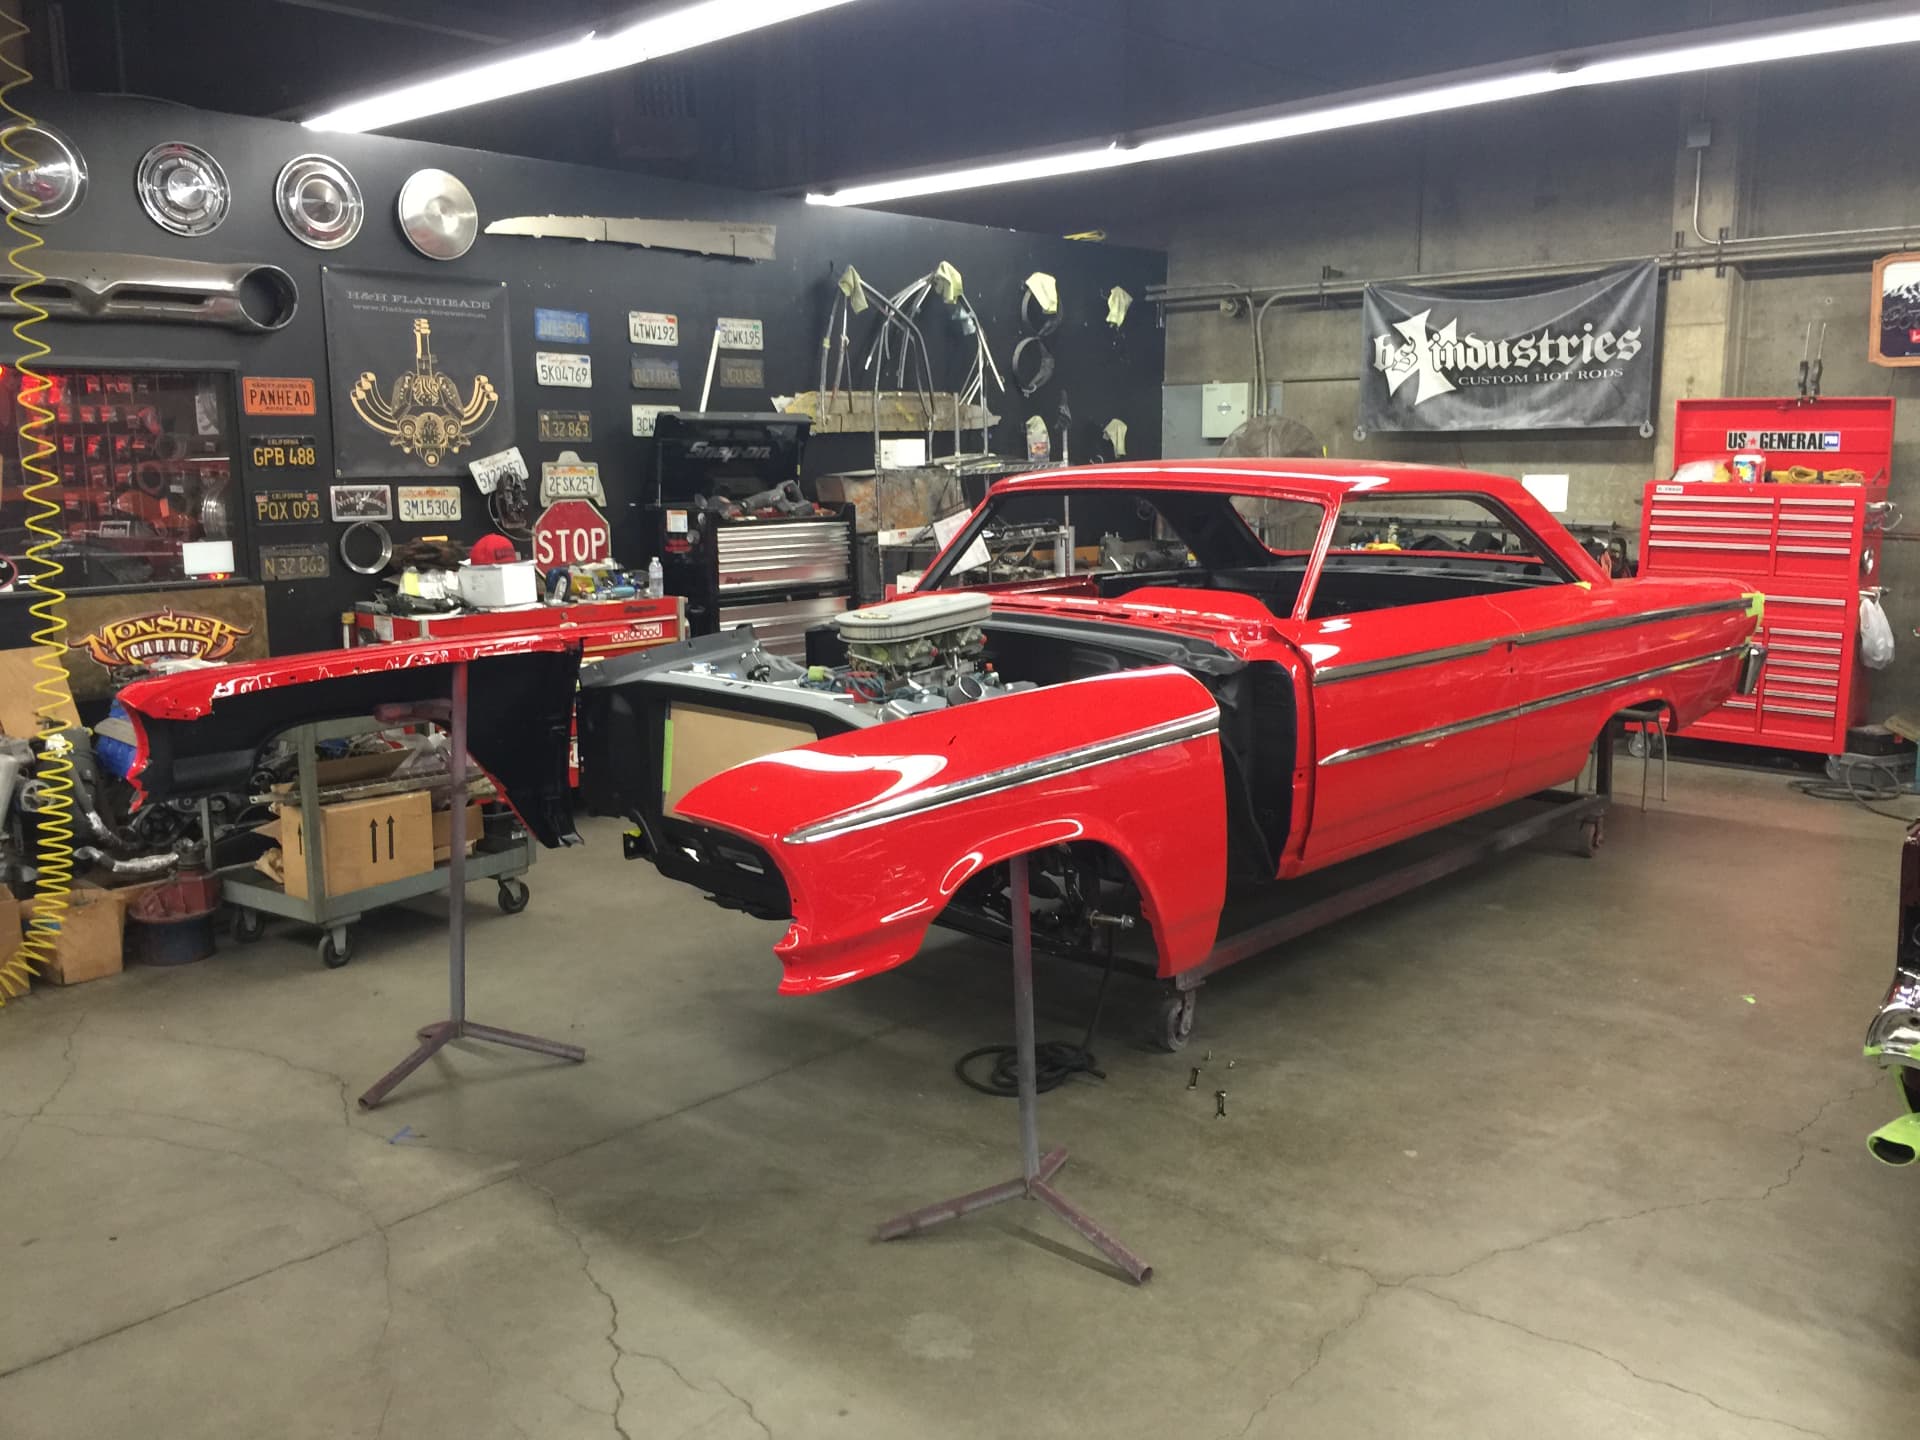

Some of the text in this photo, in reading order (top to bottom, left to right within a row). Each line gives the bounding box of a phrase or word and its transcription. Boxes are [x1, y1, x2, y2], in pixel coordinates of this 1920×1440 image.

[391, 294, 491, 309] FLATHEADS
[633, 323, 675, 342] 4TWV192
[722, 329, 760, 346] 3CWK195
[1430, 322, 1642, 372] industries
[1458, 367, 1624, 386] CUSTOM HOT RODS
[249, 389, 310, 406] PANHEAD
[1728, 432, 1747, 449] US
[1759, 432, 1825, 450] GENERAL
[253, 447, 316, 466] GPB 488
[549, 475, 595, 494] 2FSK257
[293, 501, 319, 519] 093
[537, 527, 606, 564] STOP
[130, 638, 202, 658] GARAGE
